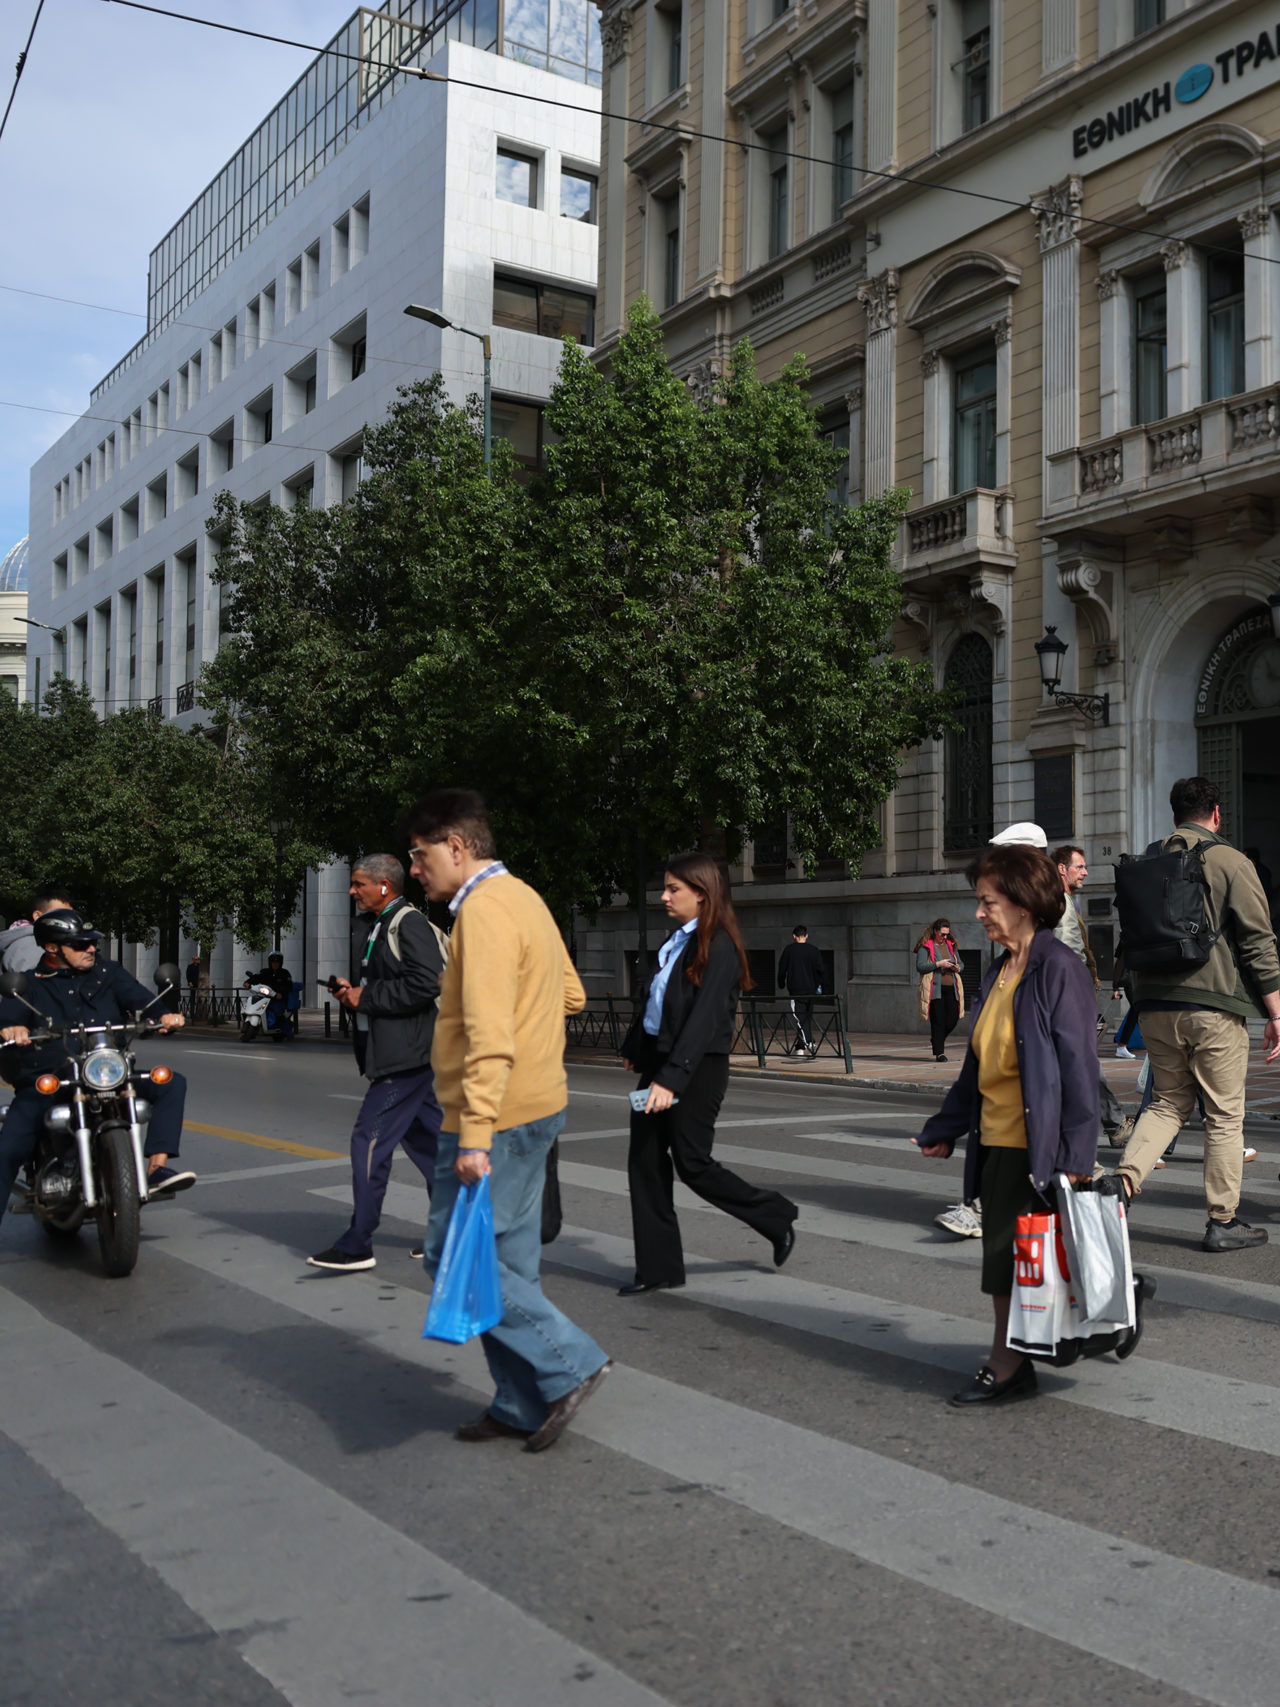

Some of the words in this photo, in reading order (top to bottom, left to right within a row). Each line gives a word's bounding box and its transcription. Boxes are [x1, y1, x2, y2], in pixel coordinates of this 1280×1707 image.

[1073, 81, 1171, 159] ΕΘΝΙΚΗ
[1197, 653, 1221, 713] ΕΘΝΙΚΗ
[1218, 615, 1272, 652] ΤΡΑΠΕΖΑ
[1102, 846, 1112, 857] 38
